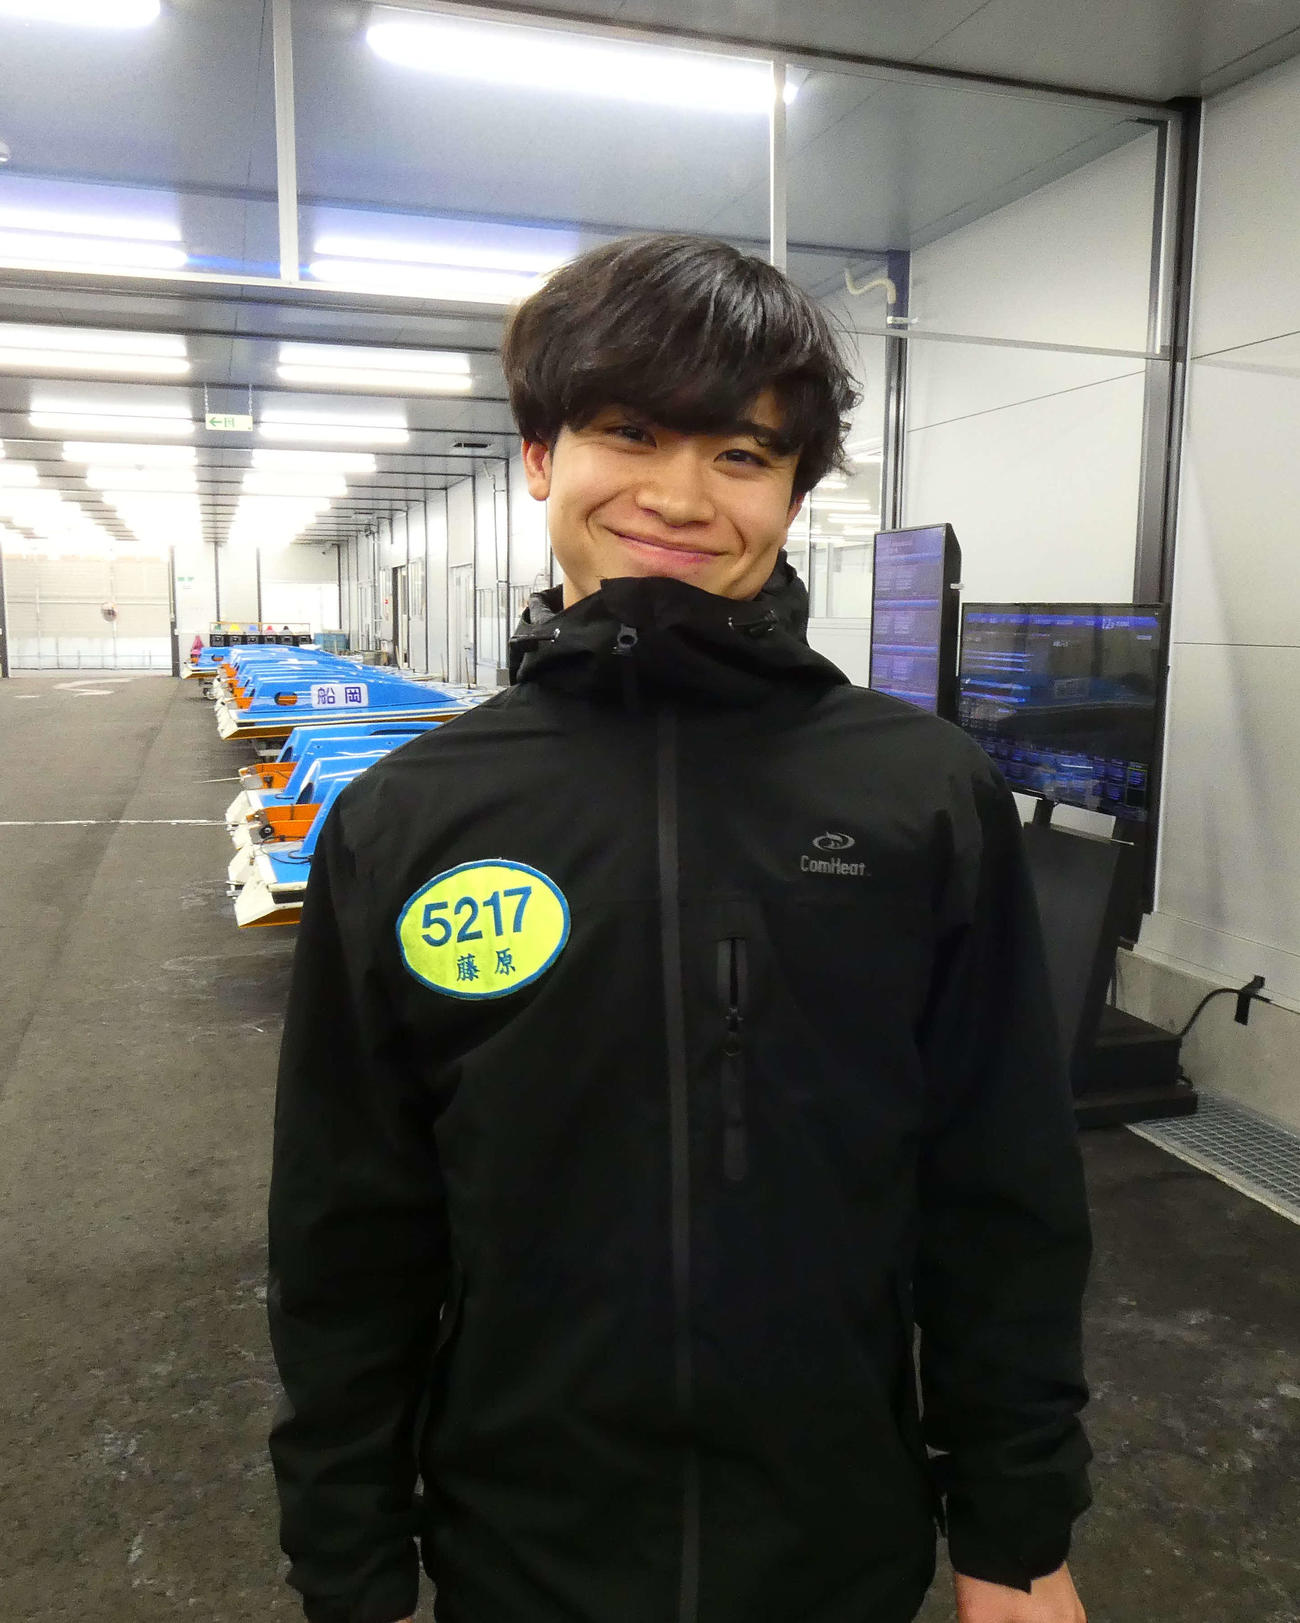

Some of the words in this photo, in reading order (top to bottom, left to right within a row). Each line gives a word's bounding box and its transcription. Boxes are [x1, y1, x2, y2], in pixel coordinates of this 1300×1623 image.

[317, 687, 362, 704] 船岡
[421, 886, 532, 947] 5217
[456, 948, 516, 982] 藤原
